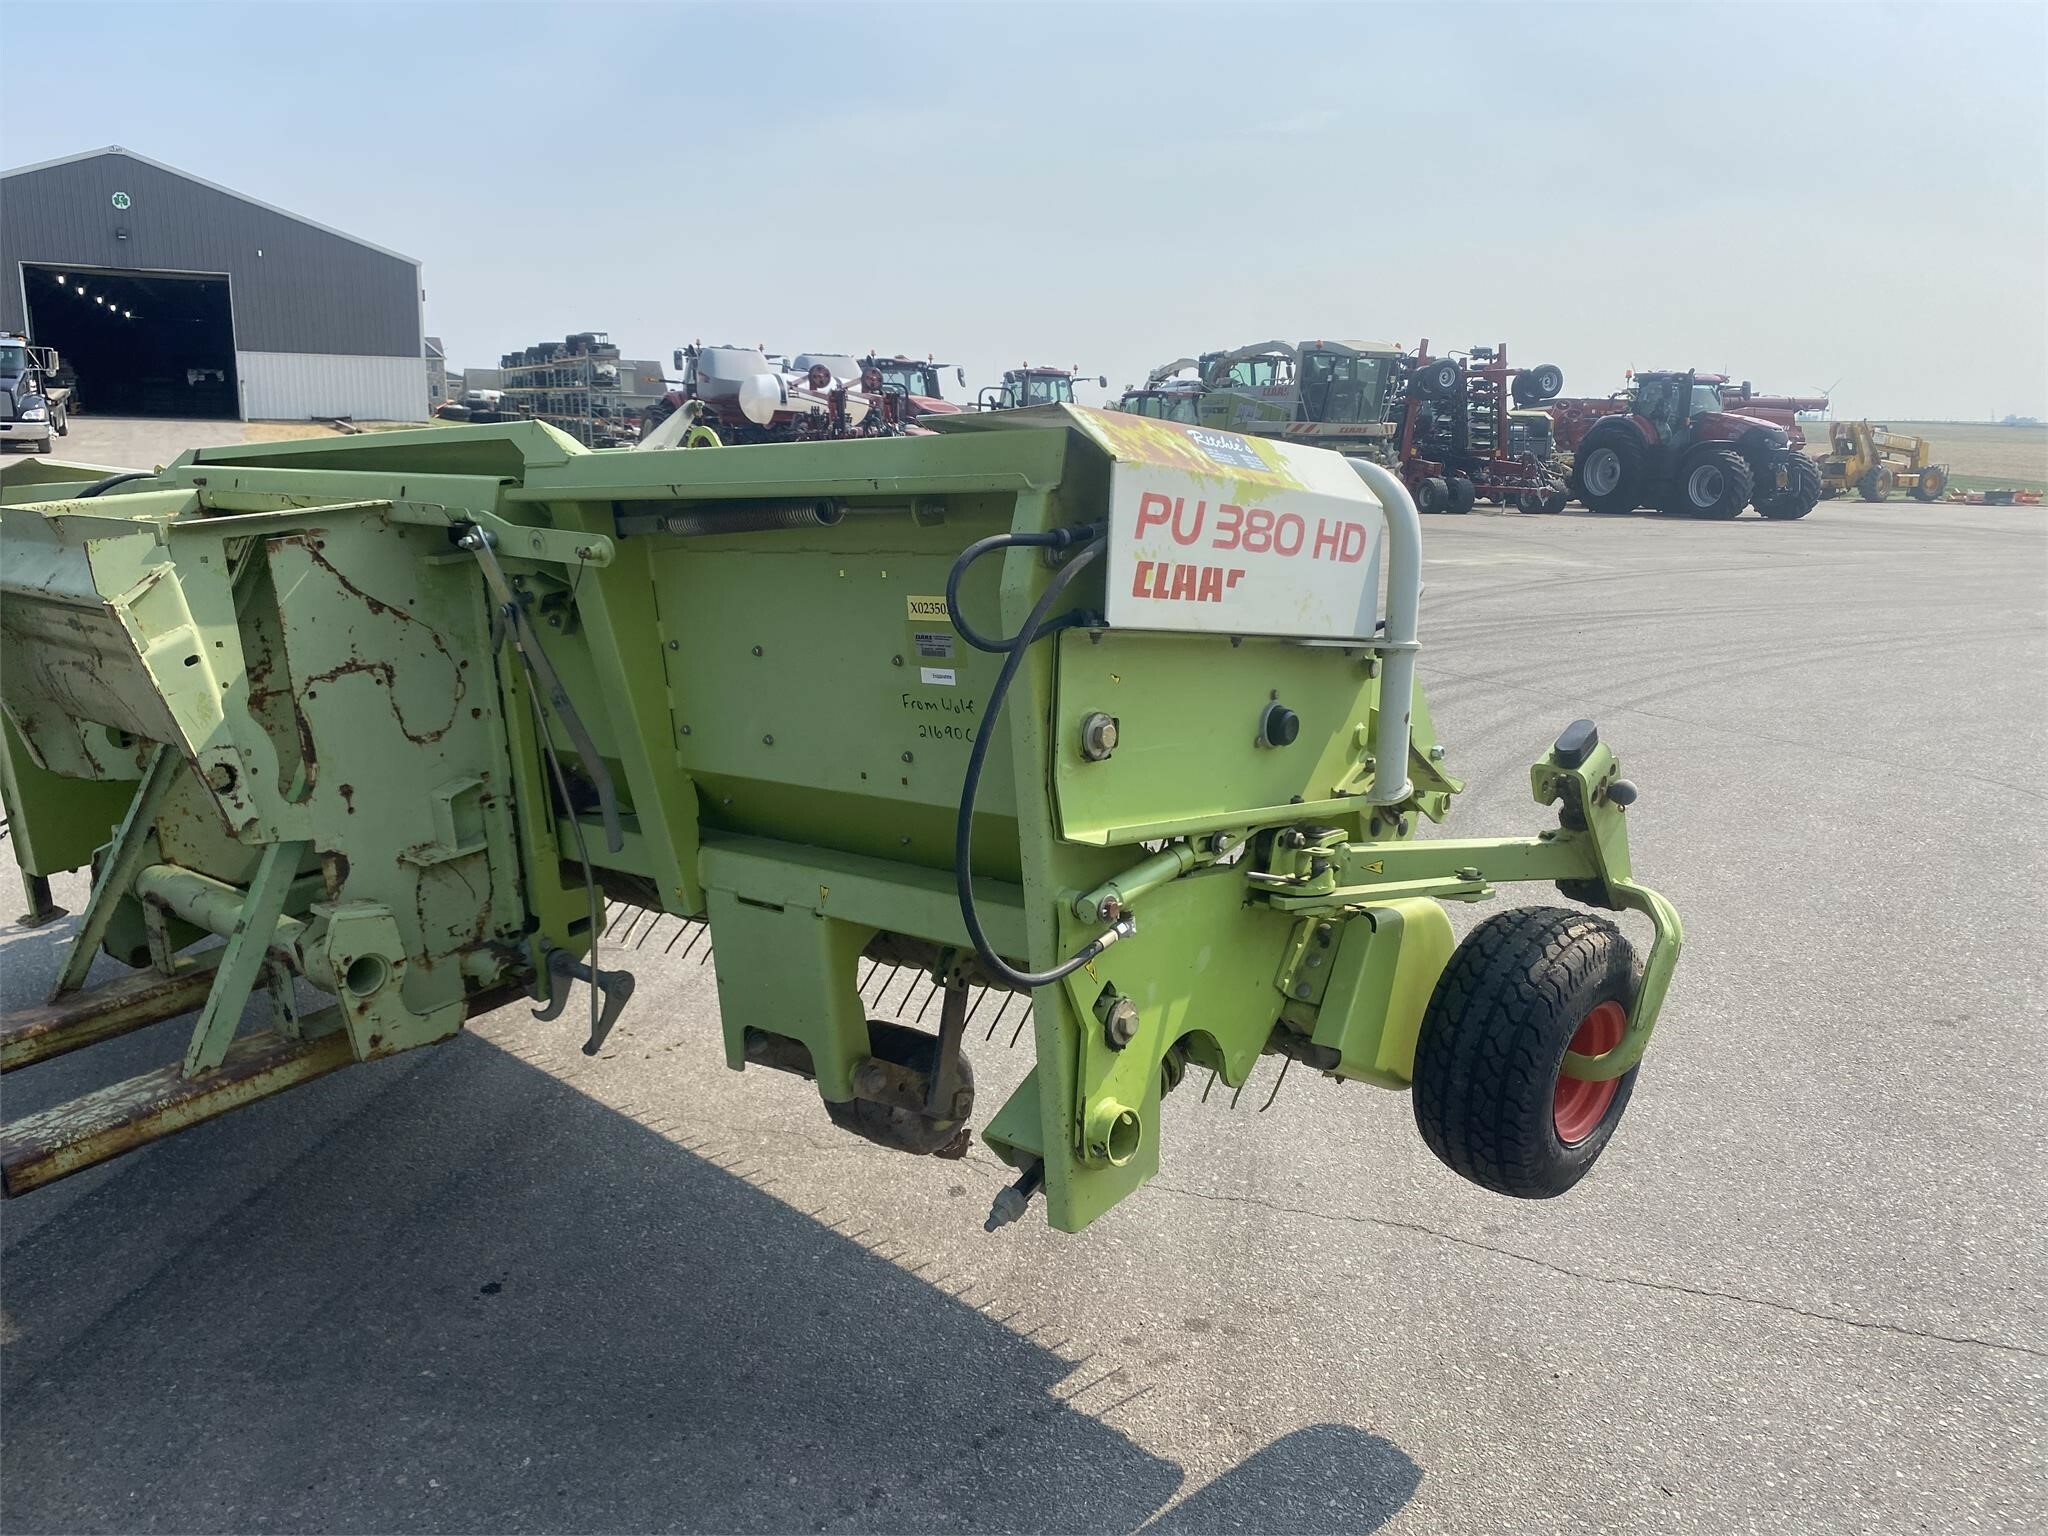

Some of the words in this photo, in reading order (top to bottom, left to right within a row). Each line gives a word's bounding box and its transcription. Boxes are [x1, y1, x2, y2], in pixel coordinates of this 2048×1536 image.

[1134, 492, 1206, 546] PU
[1212, 503, 1305, 557] 380
[1313, 518, 1367, 563] HD
[910, 601, 949, 615] X02350
[902, 693, 938, 711] From
